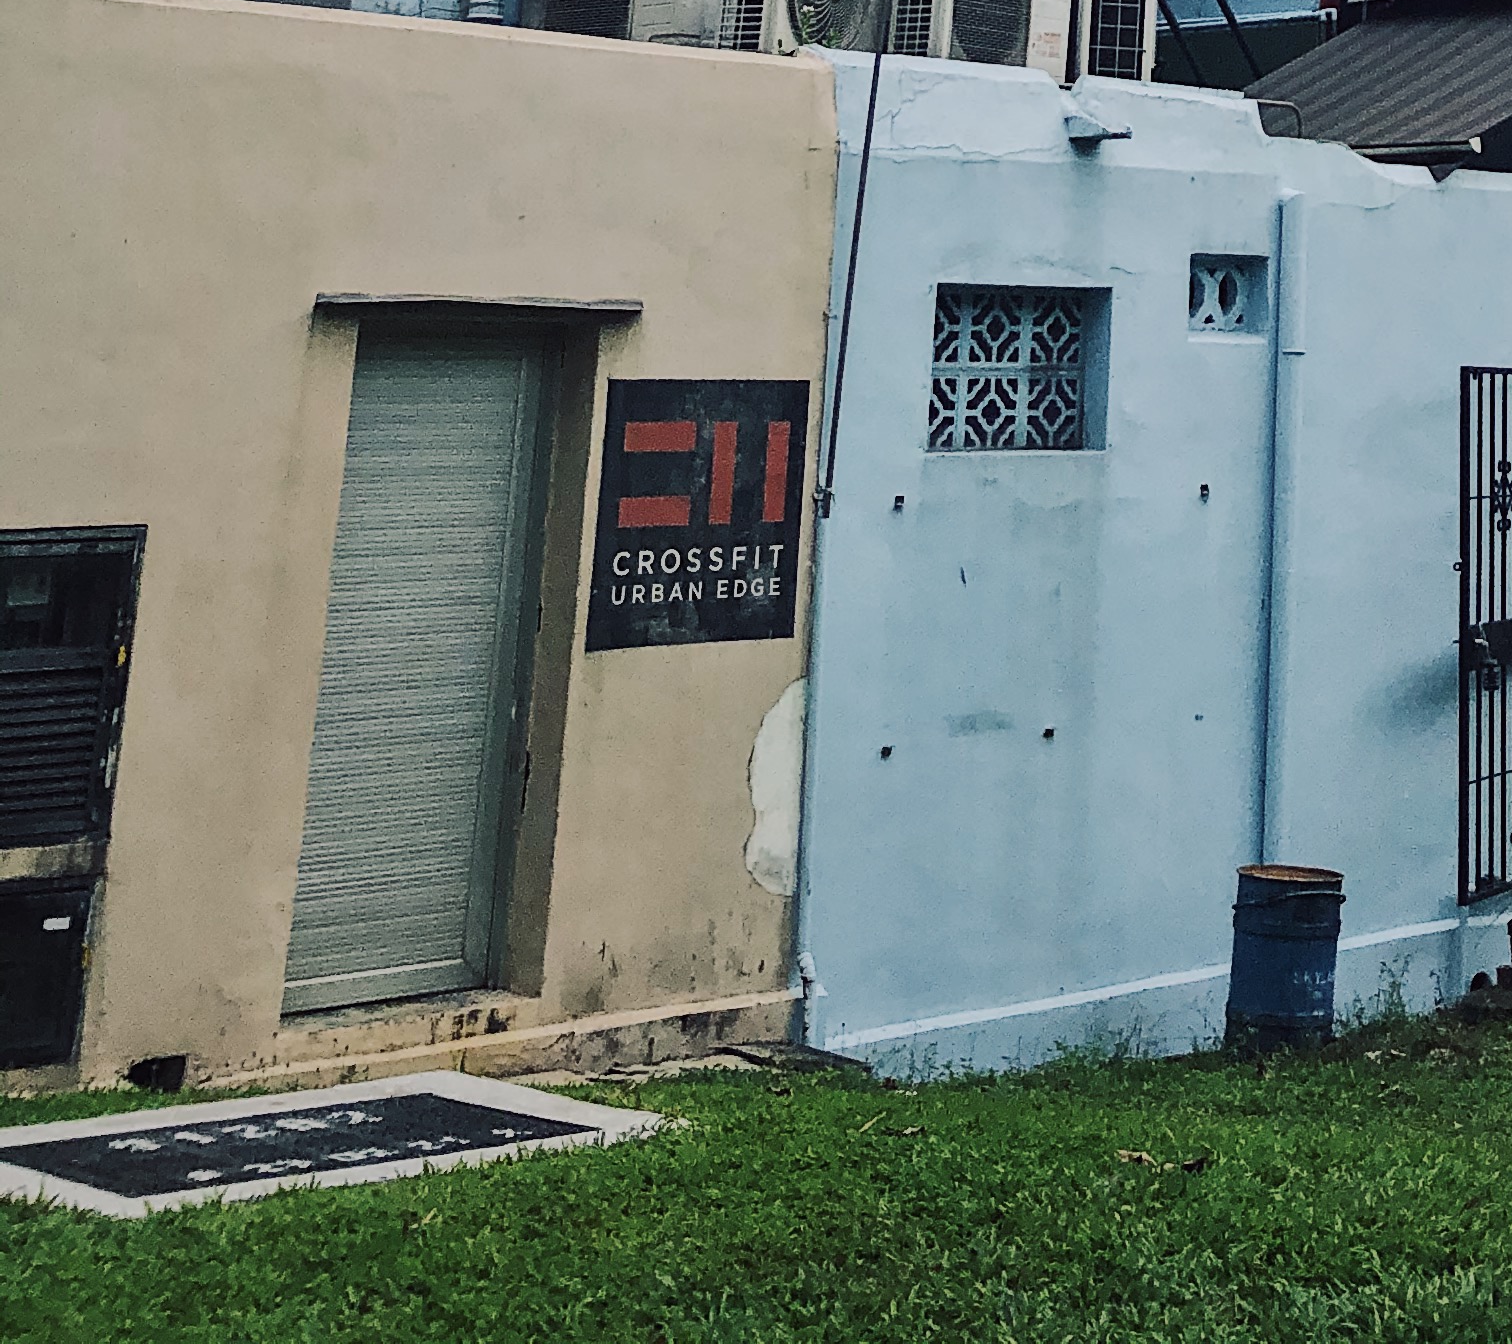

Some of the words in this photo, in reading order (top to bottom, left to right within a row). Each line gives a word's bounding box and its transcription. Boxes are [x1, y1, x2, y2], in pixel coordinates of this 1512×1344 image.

[612, 544, 784, 577] CROSSFIT
[611, 580, 703, 606] URBAN
[716, 576, 782, 599] EDGE
